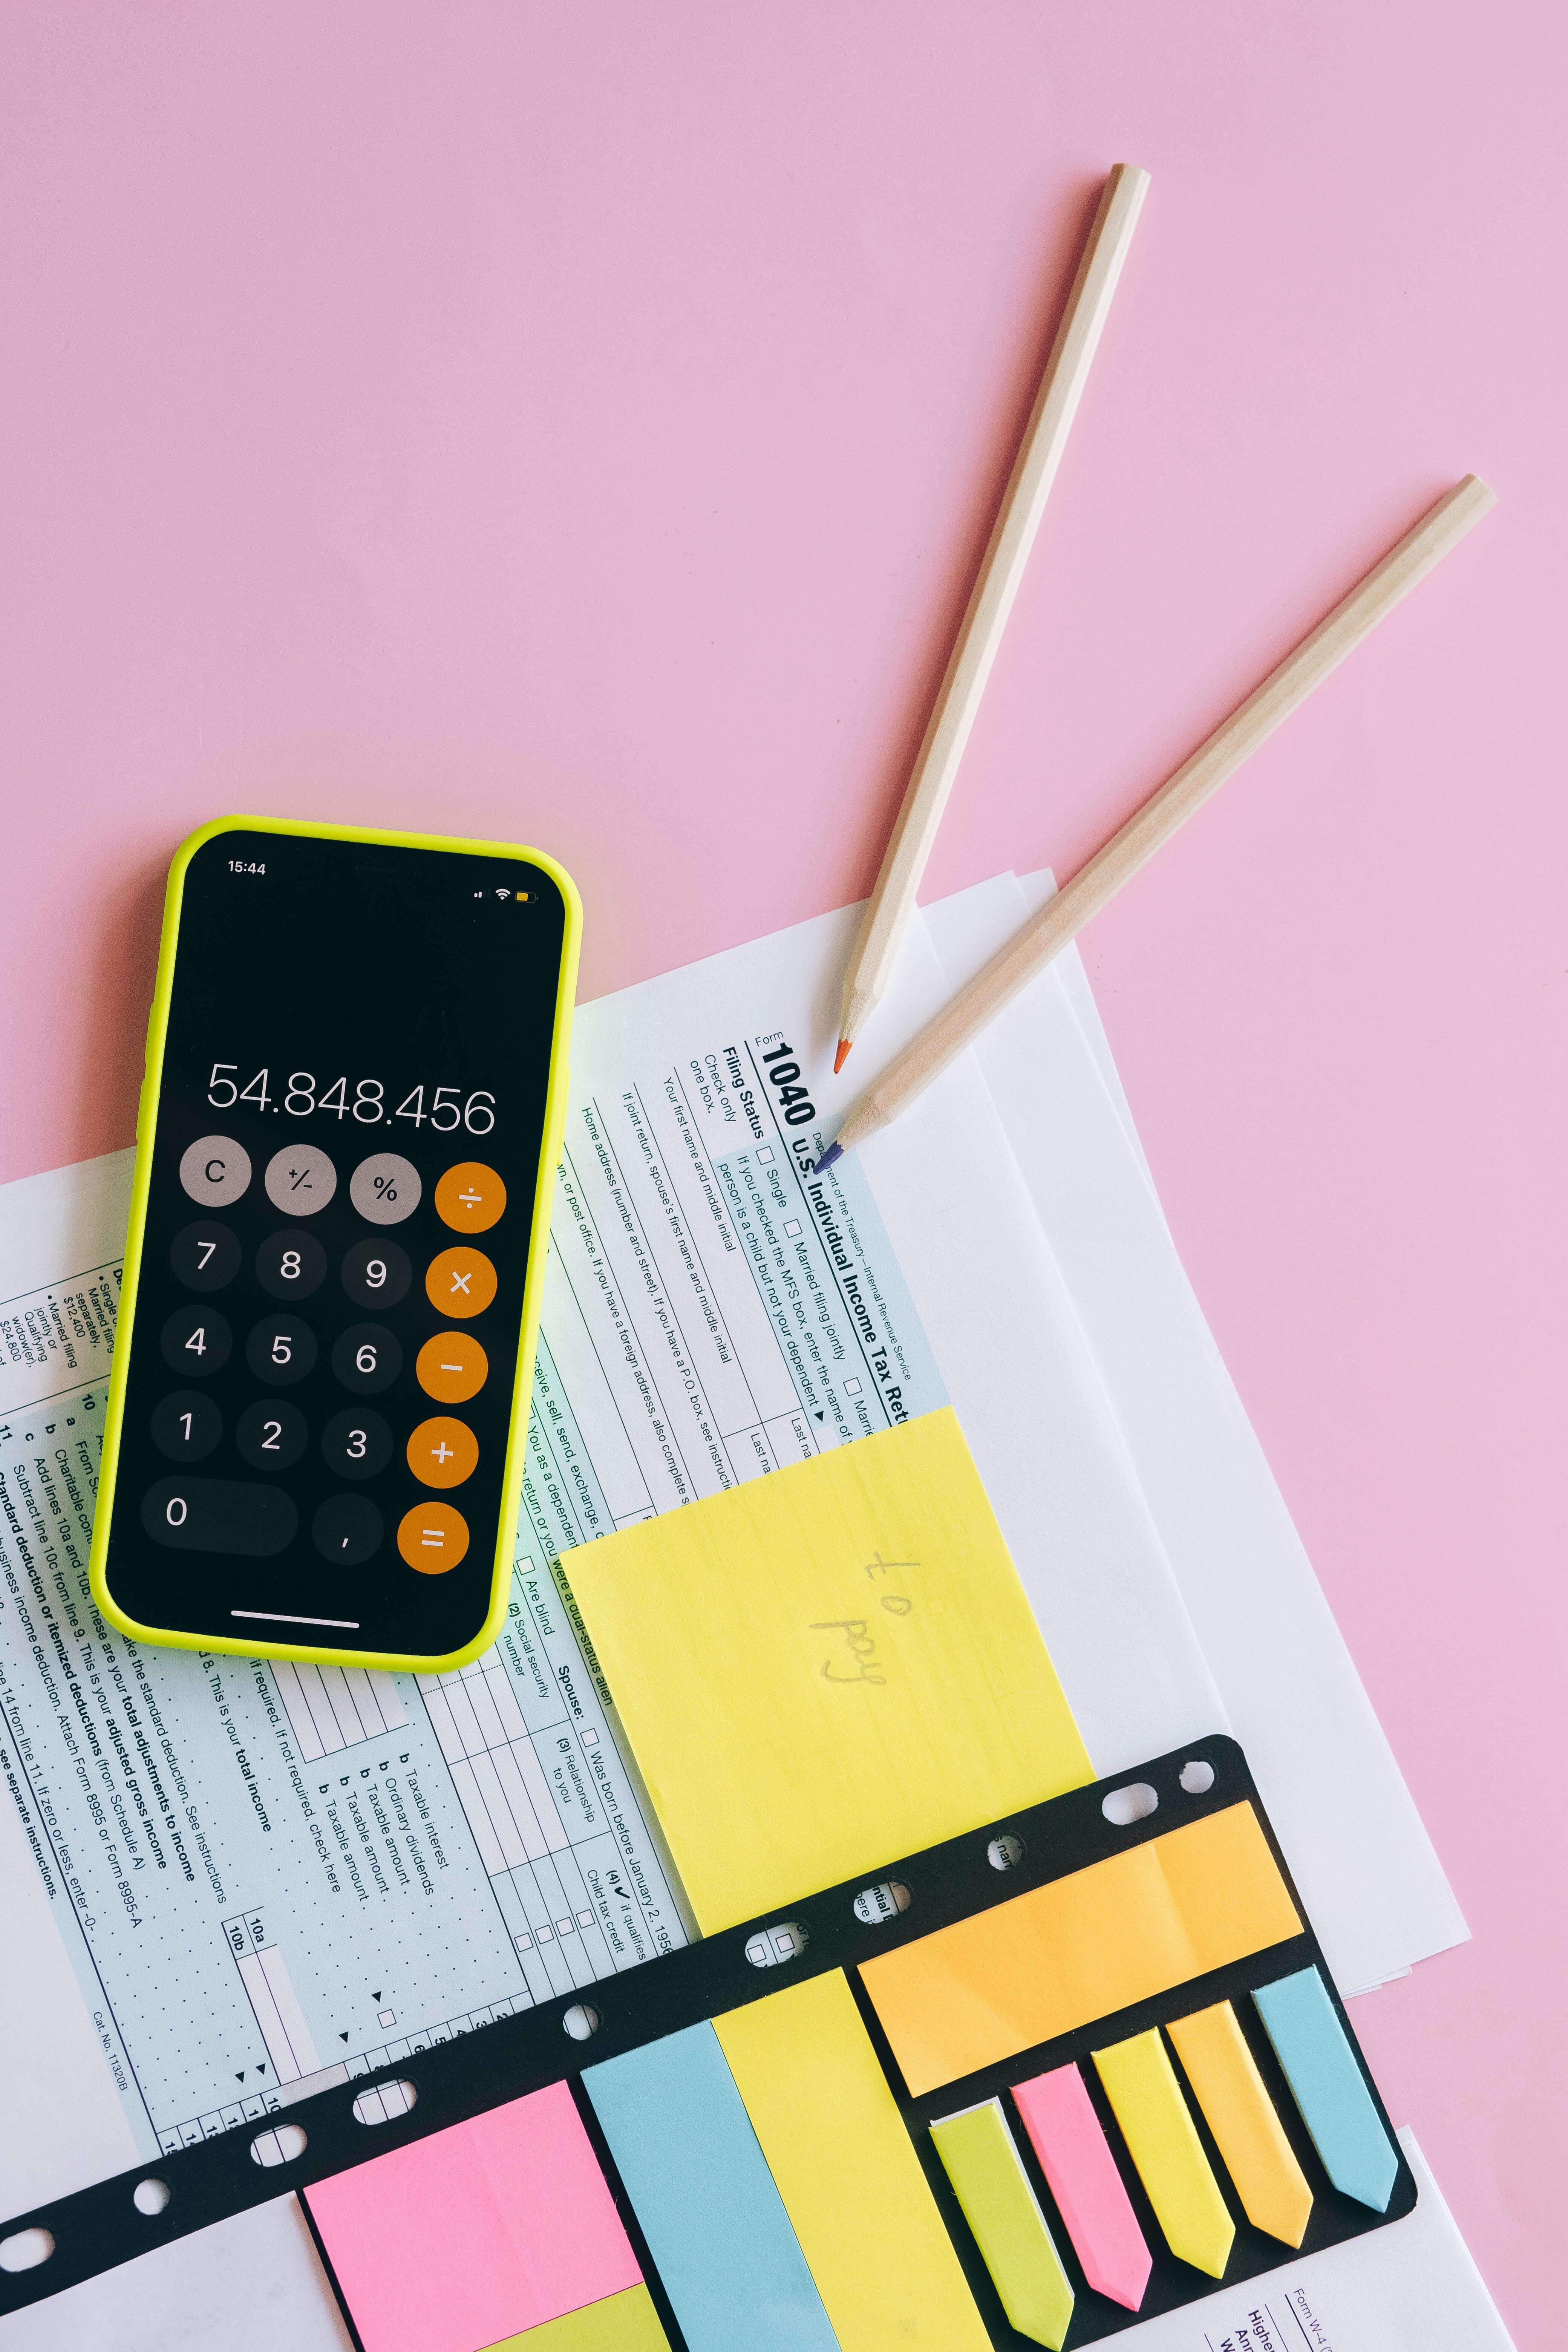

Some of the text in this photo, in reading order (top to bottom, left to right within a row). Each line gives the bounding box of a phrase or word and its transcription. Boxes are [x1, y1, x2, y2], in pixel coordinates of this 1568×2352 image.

[228, 861, 266, 875] 15:44
[754, 1031, 784, 1047] Form
[207, 1063, 495, 1134] 54.848.456
[690, 1060, 715, 1114] one box.
[704, 1054, 737, 1122] Check only
[722, 1046, 764, 1139] Filing Status
[762, 1041, 816, 1126] 1040
[205, 1159, 226, 1183] C
[663, 1076, 737, 1252] Your first name and middle initial
[812, 1132, 839, 1188] Depament
[374, 1177, 397, 1201] %
[766, 1169, 787, 1208] Single
[834, 1189, 845, 1199] of
[838, 1200, 848, 1216] the
[198, 1242, 216, 1269] 7
[280, 1251, 300, 1279] 8
[366, 1260, 386, 1288] 9
[792, 1138, 909, 1424] U.S. Individual Income Tax Ret
[100, 1283, 118, 1316] Single
[716, 1163, 820, 1407] person is a child but not your dependent
[737, 1155, 853, 1438] If you checked the MFS box, enter the name of
[793, 1241, 845, 1360] Married filing jointly
[0, 1320, 22, 1361] $24,800
[12, 1315, 37, 1368] widow(er),
[24, 1311, 48, 1362] Qualifying
[33, 1306, 58, 1349] jointly or
[47, 1302, 78, 1369] Married filing
[63, 1296, 86, 1338] $12,400
[75, 1292, 101, 1348] separately,
[87, 1287, 115, 1355] Married filing
[185, 1328, 206, 1355] 4
[877, 1303, 897, 1344] Revenue
[272, 1336, 291, 1364] 5
[356, 1345, 377, 1373] 6
[893, 1345, 911, 1381] Service
[180, 1413, 192, 1440] 1
[262, 1421, 281, 1449] 2
[347, 1430, 366, 1458] 3
[791, 1417, 808, 1442] Last
[853, 1400, 875, 1436] Marri
[167, 1498, 187, 1526] 0
[15, 1536, 47, 1604] deduction
[863, 1551, 921, 1617] to
[41, 1605, 54, 1620] or
[525, 1581, 556, 1636] Are blind
[0, 1425, 167, 1870] 11 Subtract line 10c from line 9. This is your adjusted gross income
[47, 1621, 78, 1680] itemized
[503, 1634, 525, 1677] number
[507, 1603, 550, 1698] (2) Social security
[808, 1619, 887, 1685] pay
[558, 1665, 584, 1720] Spouse:
[69, 1682, 102, 1757] deductions
[14, 1595, 142, 1929] income deduction. Attach Form 8995 or Form 8995-A
[95, 1759, 115, 1792] (from
[249, 1658, 341, 1893] if required. If not required, check here
[553, 1767, 572, 1804] to you
[556, 1738, 595, 1822] (3) Relationship
[0, 1749, 57, 1900] see separate instructions.
[110, 1794, 138, 1854] Schedule
[378, 1760, 435, 1896] b Ordinary dividends
[399, 1752, 450, 1870] b Taxable interest
[590, 1750, 606, 1780] Was
[600, 1781, 618, 1812] born
[612, 1813, 634, 1855] before
[629, 1858, 654, 1906] January
[648, 1909, 660, 1923] 2,
[132, 1857, 146, 1870] A)
[229, 1925, 245, 1951] 10b
[250, 1917, 265, 1943] 10a
[587, 1869, 625, 1954] Child tax credit
[605, 1870, 646, 1961] (4) if qualifies
[93, 2011, 128, 2091] Cat. No. 11320B
[1235, 2329, 1254, 2352] Ann
[1293, 2288, 1327, 2345] Form W-4
